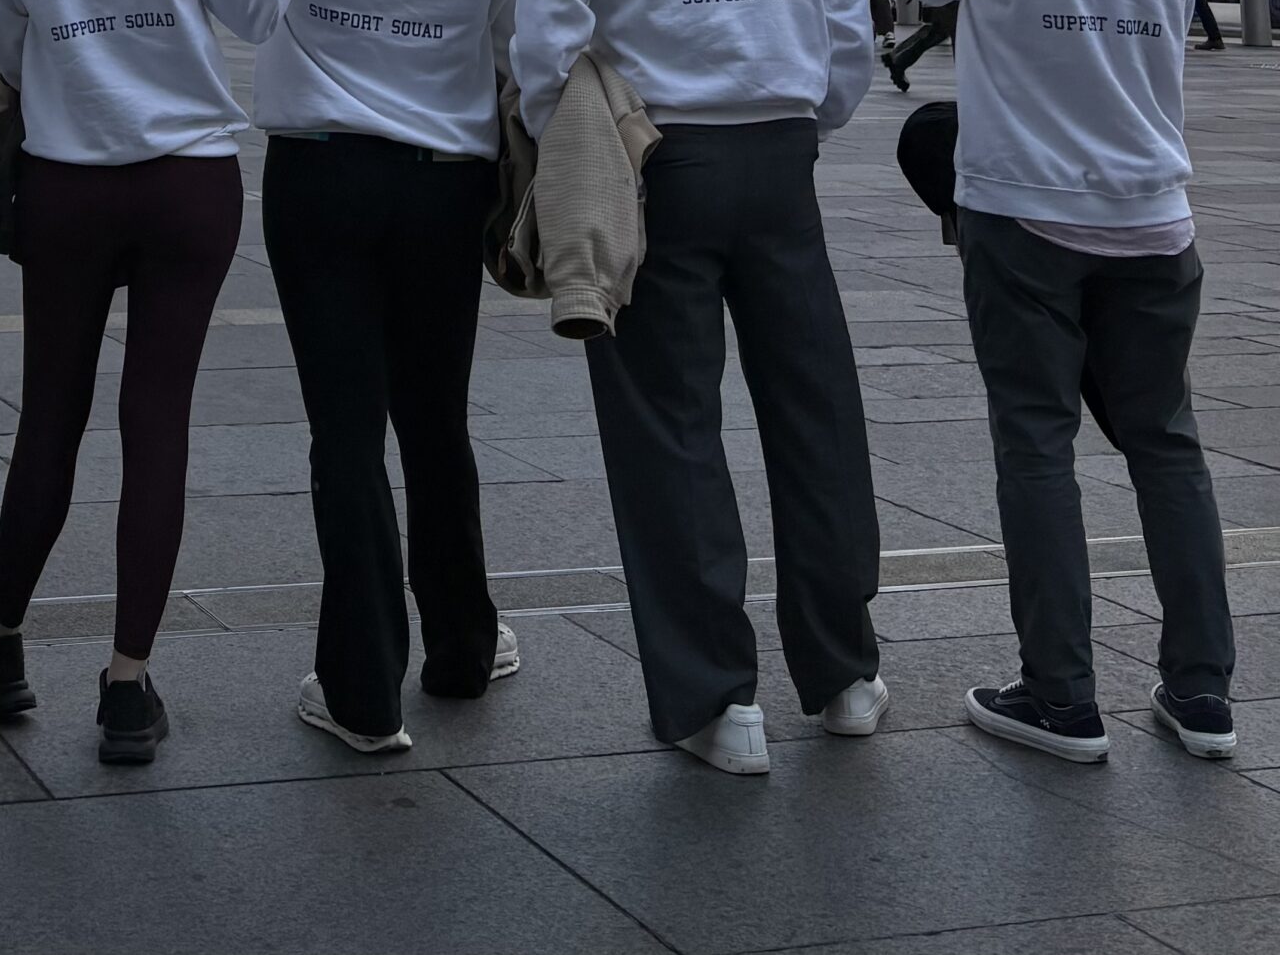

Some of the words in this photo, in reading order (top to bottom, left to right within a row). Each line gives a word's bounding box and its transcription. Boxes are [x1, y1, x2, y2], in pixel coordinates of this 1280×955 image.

[50, 16, 116, 42] SUPPORT
[124, 12, 175, 29] SQUAD
[308, 3, 384, 32] SUPPORT
[391, 19, 443, 39] SQUAD
[1116, 19, 1162, 38] SQUAD
